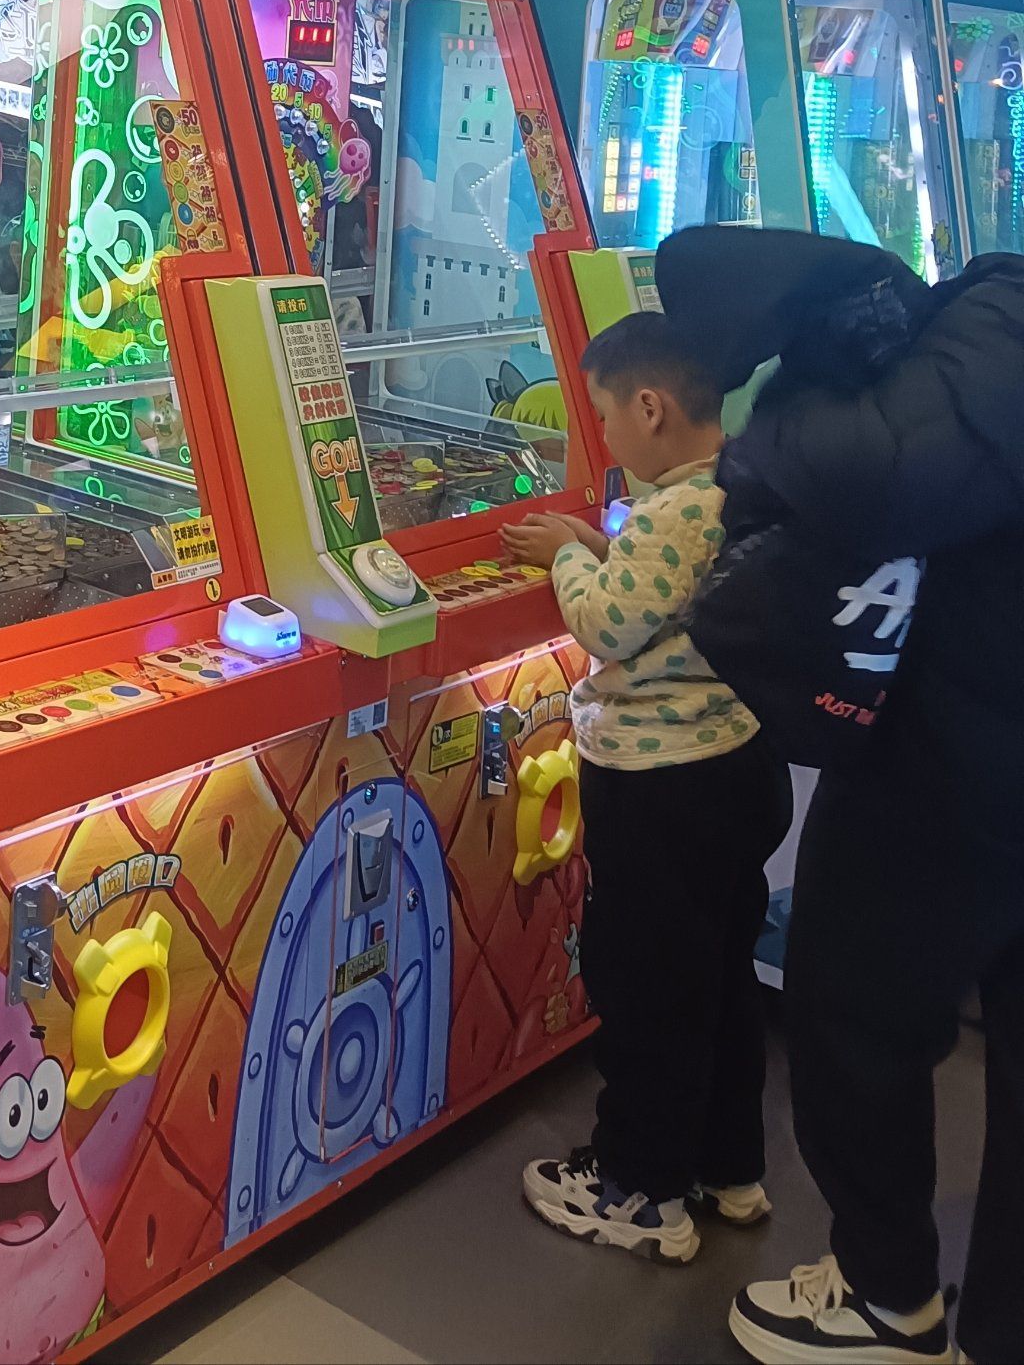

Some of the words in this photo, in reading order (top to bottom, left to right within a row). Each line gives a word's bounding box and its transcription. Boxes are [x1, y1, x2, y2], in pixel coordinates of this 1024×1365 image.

[180, 108, 199, 127] 50
[270, 83, 289, 103] 20
[293, 91, 304, 110] 5
[323, 123, 334, 141] 5
[276, 298, 307, 315] 请投币
[310, 435, 362, 480] GO!!
[173, 523, 202, 542] 文明游玩
[176, 541, 217, 561] 请勿拍打机器
